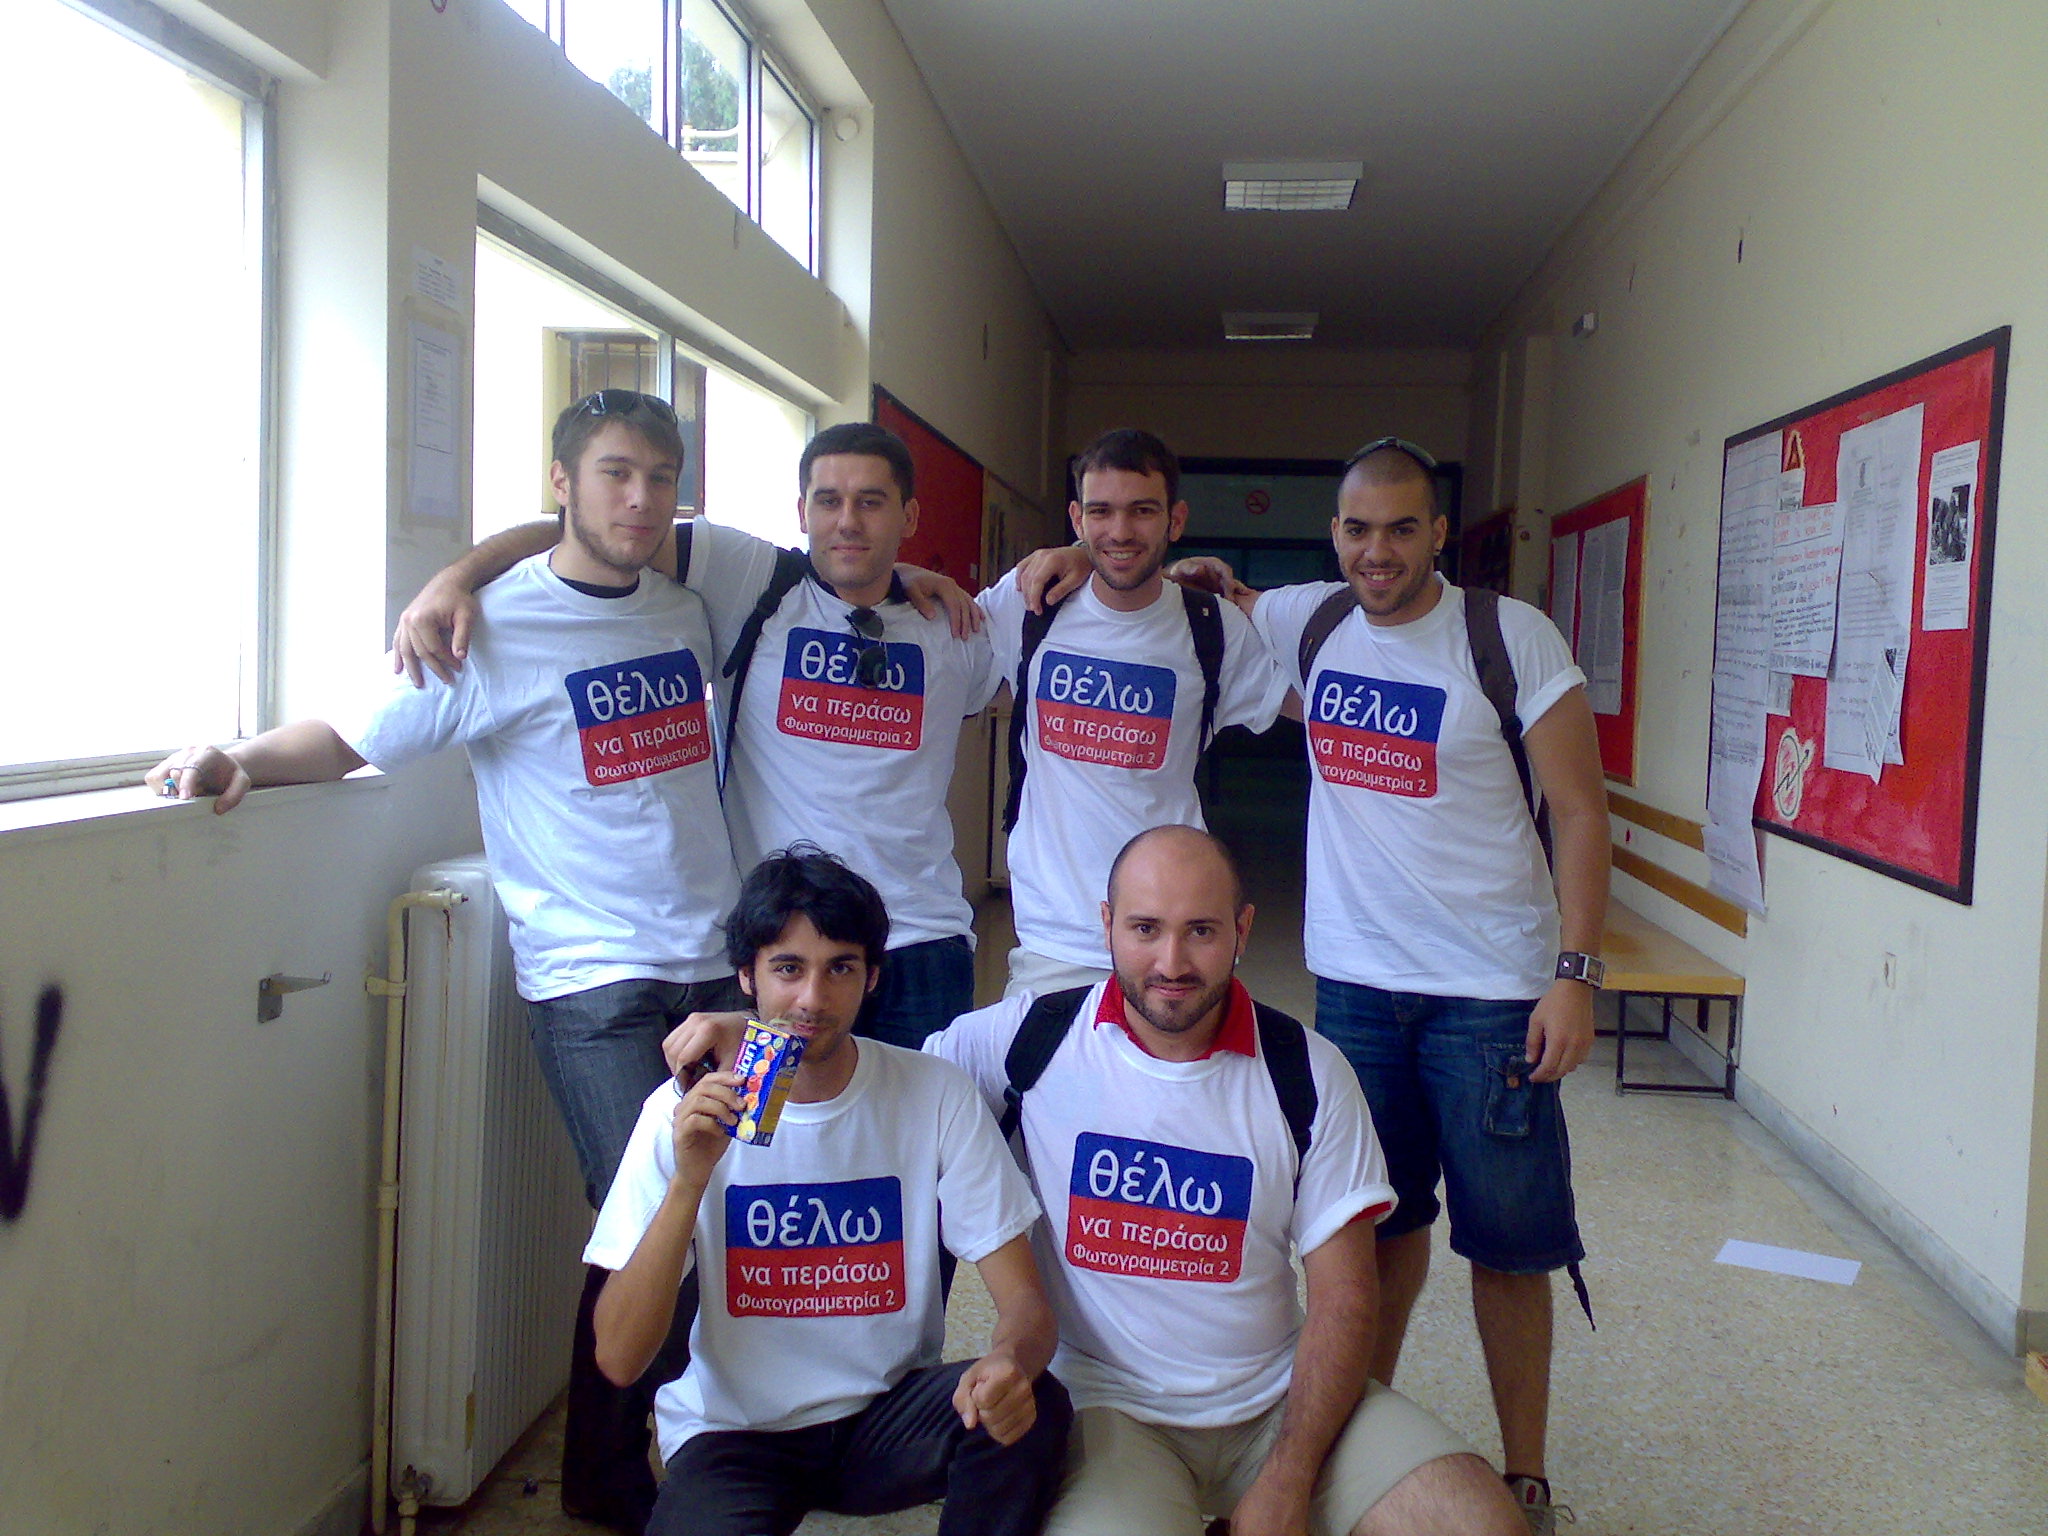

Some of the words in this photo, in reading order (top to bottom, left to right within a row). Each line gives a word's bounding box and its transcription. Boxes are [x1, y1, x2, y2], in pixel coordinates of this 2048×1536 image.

[587, 671, 688, 722] θέλω
[1050, 664, 1154, 714] θέλω
[792, 693, 819, 713] να
[827, 698, 911, 724] περάσω
[1320, 682, 1418, 736] θέλω
[594, 736, 625, 757] να
[630, 717, 701, 749] περάσω
[784, 716, 900, 745] Φωτογραμμετρία
[904, 731, 912, 745] 2
[1043, 714, 1065, 733] να
[1073, 719, 1157, 745] περάσω
[699, 741, 706, 754] 2
[1044, 734, 1144, 764] Φτογραμμετρία
[1147, 752, 1156, 765] 2
[1313, 737, 1335, 755] να
[1342, 741, 1423, 771] περάσω
[1319, 764, 1414, 791] τογραμμετρία
[1418, 779, 1427, 792] 2
[1089, 1149, 1223, 1215] θέλω
[747, 1195, 883, 1247] θέλω
[1078, 1215, 1112, 1239] να
[1121, 1221, 1228, 1253] περάσω
[740, 1264, 772, 1285] να
[782, 1257, 891, 1289] περάσω
[1073, 1243, 1215, 1277] Φωτογραμμετρία
[1218, 1260, 1230, 1276] 2
[736, 1290, 880, 1314] Φωτογραμμετρία
[885, 1290, 895, 1305] 2
